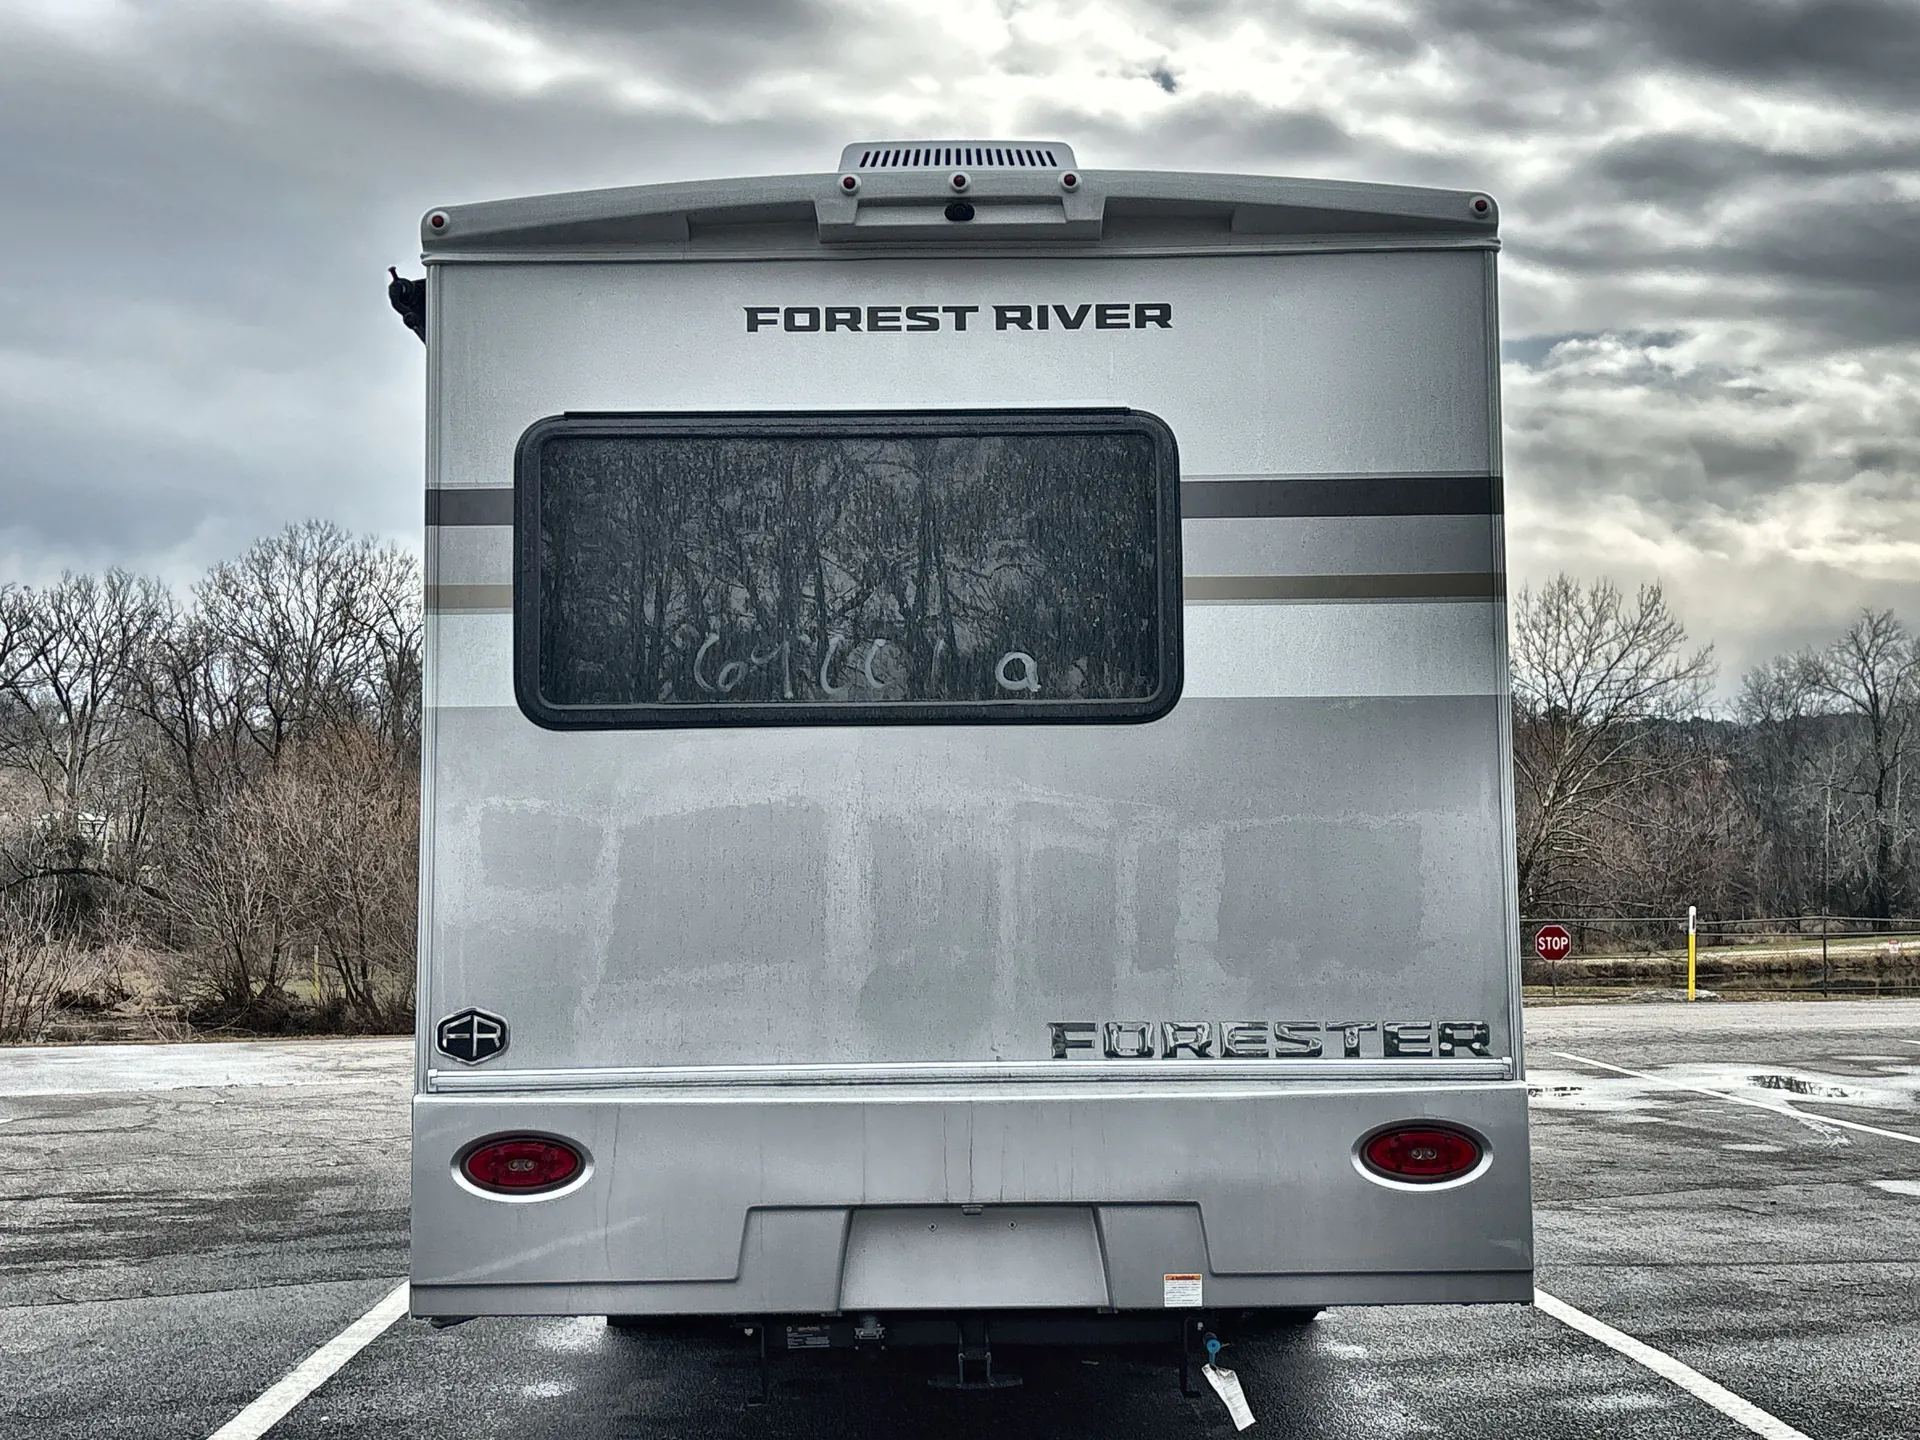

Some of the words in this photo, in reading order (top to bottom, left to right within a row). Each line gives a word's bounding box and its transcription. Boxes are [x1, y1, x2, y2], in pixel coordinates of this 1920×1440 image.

[743, 305, 979, 332] FOREST
[991, 302, 1173, 331] RIVER
[1538, 936, 1569, 951] STOP
[1047, 1020, 1493, 1059] FORESTER
